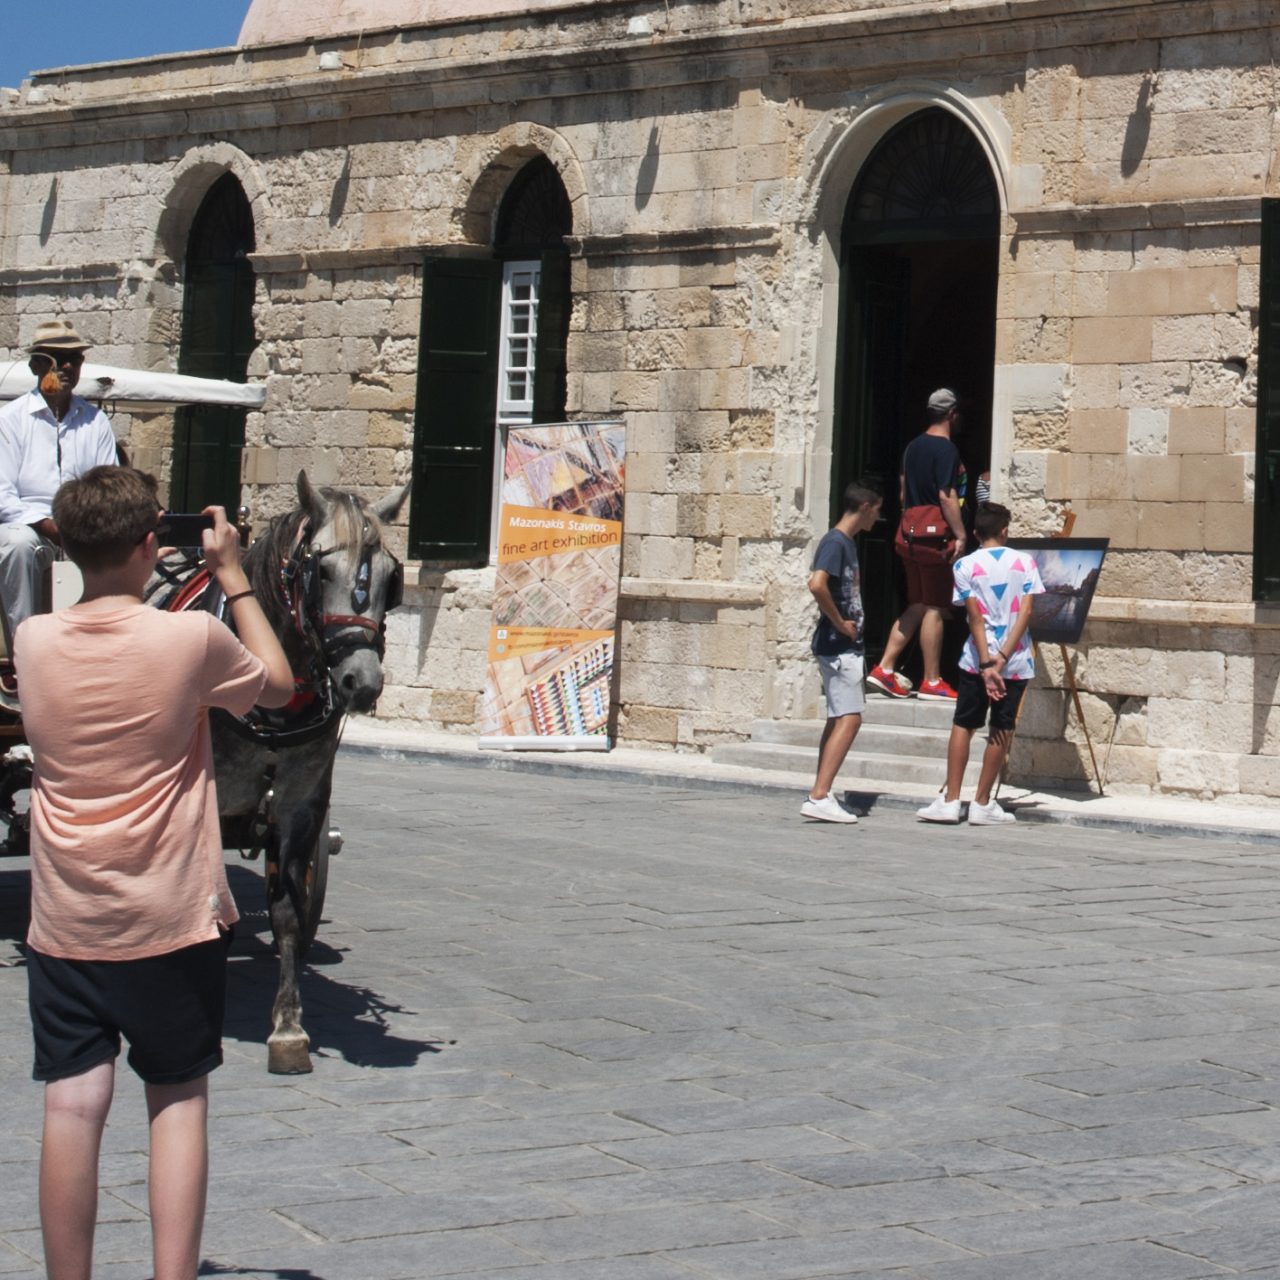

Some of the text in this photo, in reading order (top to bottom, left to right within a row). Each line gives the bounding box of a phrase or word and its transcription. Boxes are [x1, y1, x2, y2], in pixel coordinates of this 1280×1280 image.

[510, 517, 606, 532] Mazonakis Stavros
[502, 532, 618, 555] fine art exhibition
